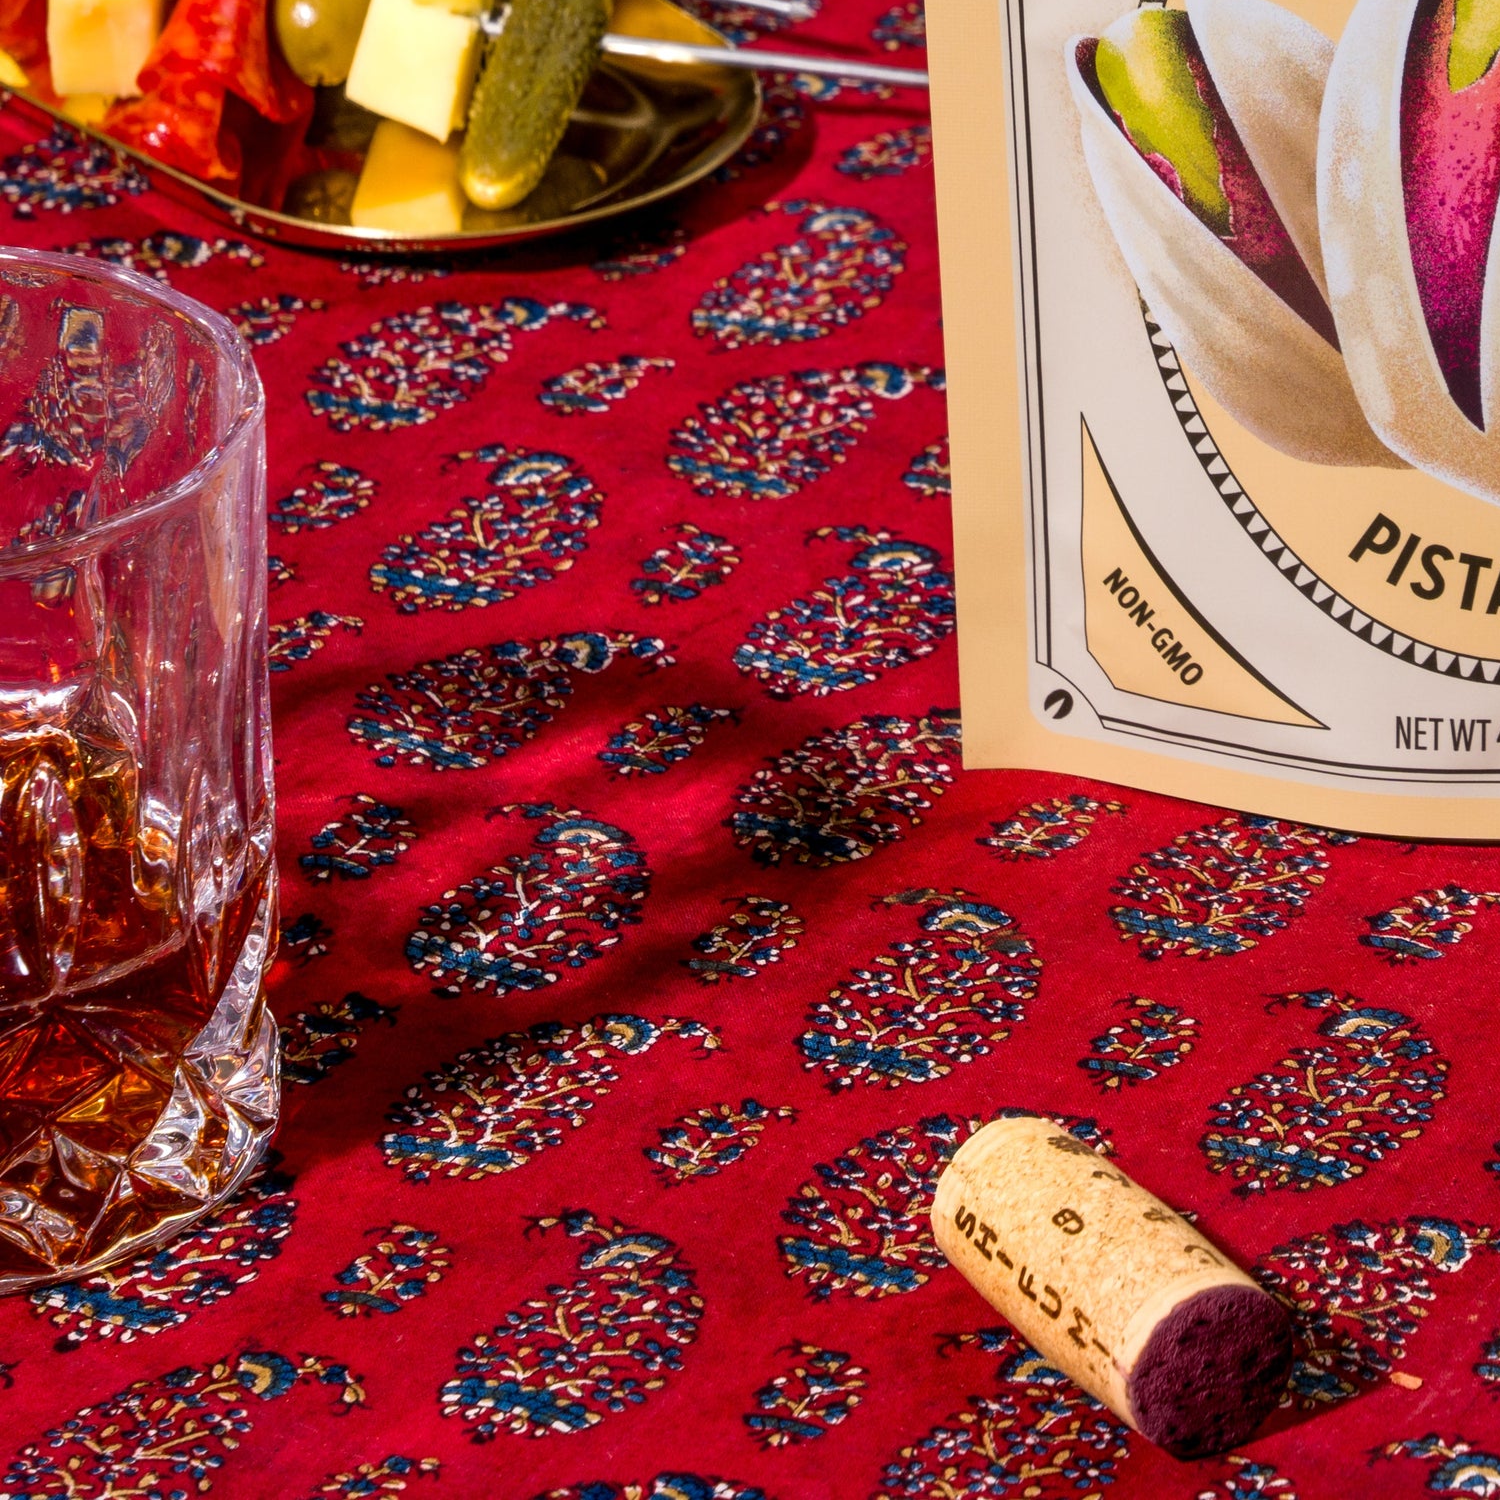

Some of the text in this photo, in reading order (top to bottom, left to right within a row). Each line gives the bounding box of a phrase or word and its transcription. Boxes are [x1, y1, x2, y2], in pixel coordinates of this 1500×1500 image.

[1103, 568, 1203, 685] NON-GMO
[1396, 716, 1444, 750] NET
[1450, 719, 1491, 751] WT
